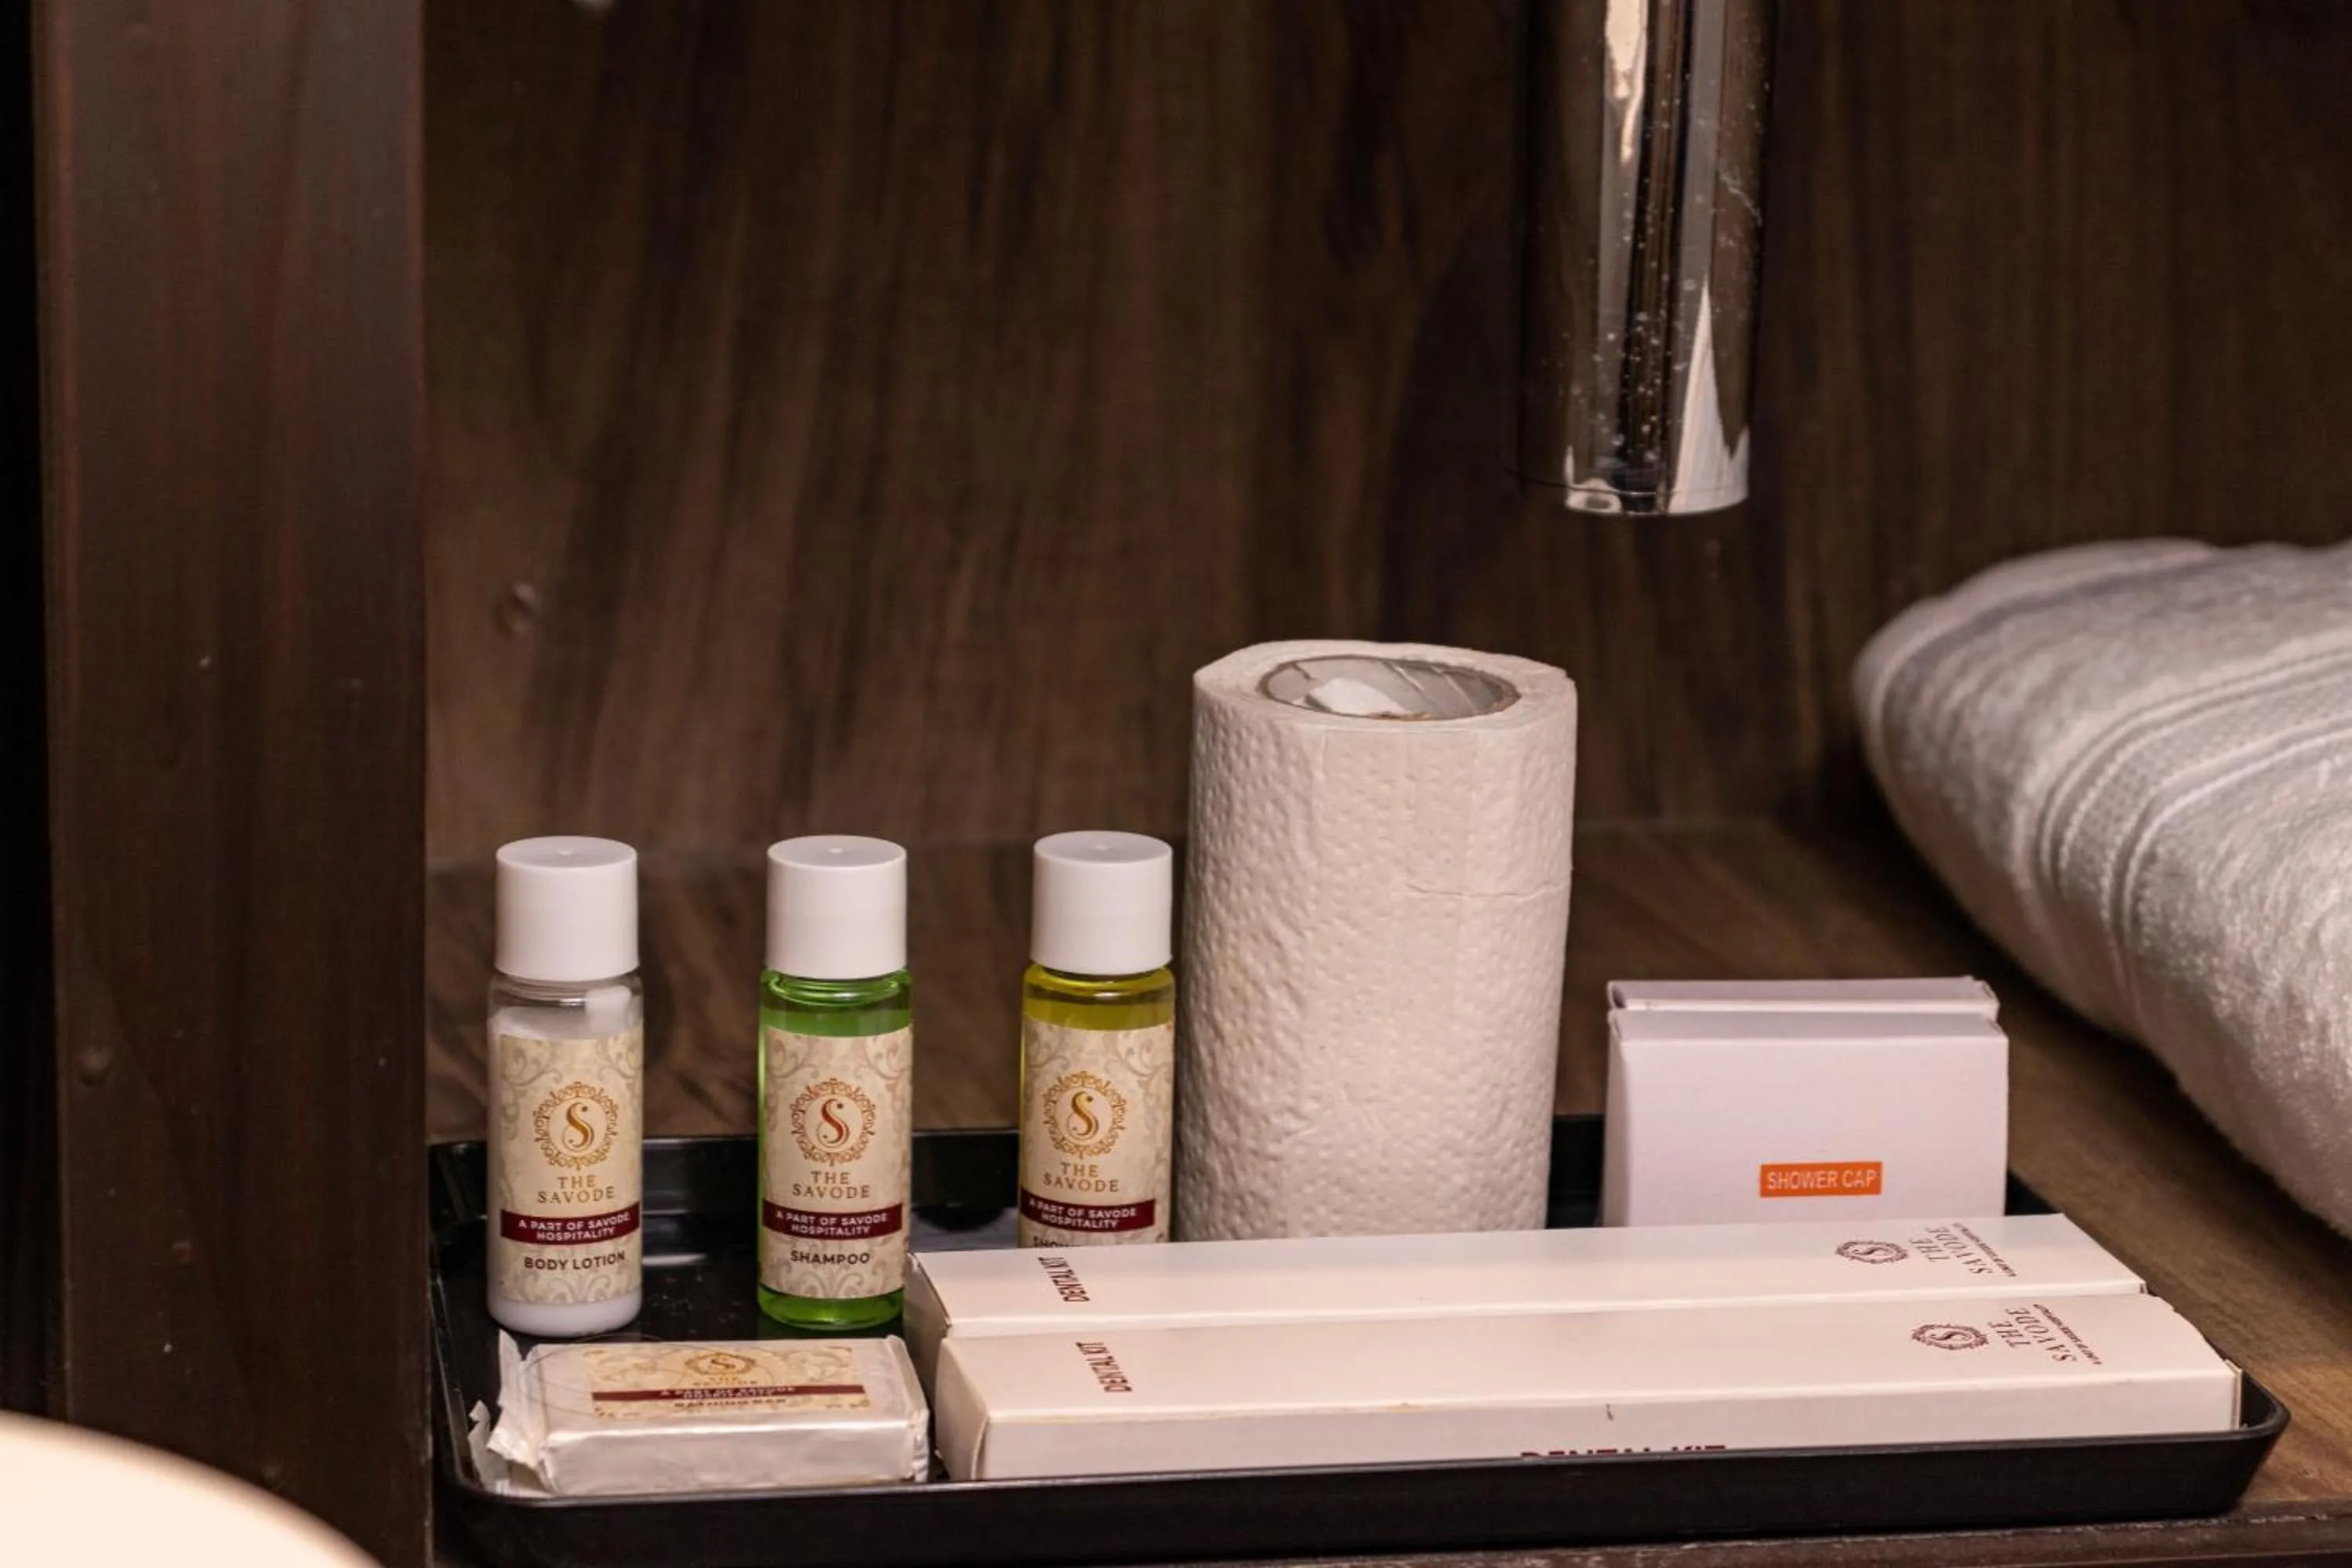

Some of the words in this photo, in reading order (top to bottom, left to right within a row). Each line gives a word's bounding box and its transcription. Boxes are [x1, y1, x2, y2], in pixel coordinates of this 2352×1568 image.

[811, 1171, 850, 1185] THE
[1060, 1162, 1099, 1178] THE
[1768, 1171, 1838, 1189] SHOWER
[1842, 1169, 1877, 1188] CAP
[557, 1175, 597, 1189] THE
[1042, 1173, 1120, 1192] SAVODE
[537, 1186, 615, 1204] SAVODE
[792, 1183, 871, 1200] SAVODE
[1029, 1198, 1036, 1207] A
[1036, 1200, 1065, 1215] PART
[1067, 1207, 1085, 1217] OF
[1088, 1208, 1137, 1219] SAVODE
[518, 1219, 528, 1229] A
[530, 1221, 562, 1231] PART
[566, 1221, 584, 1231] OF
[588, 1212, 631, 1229] SAVODE
[775, 1210, 783, 1220] A
[786, 1213, 816, 1224] PART
[819, 1217, 837, 1226] OF
[840, 1213, 888, 1226] SAVODE
[1041, 1212, 1119, 1229] HOSPITALITY
[536, 1226, 615, 1241] HOSPITALITY
[791, 1225, 871, 1236] HOSPITALITY
[790, 1250, 870, 1265] SHAMPOO
[1908, 1238, 1951, 1262] THE
[1924, 1226, 1993, 1274] SAVODE
[524, 1257, 568, 1270] BODY
[573, 1250, 626, 1269] LOTION
[1987, 1320, 2031, 1348] THE
[2005, 1307, 2077, 1361] SAVODE
